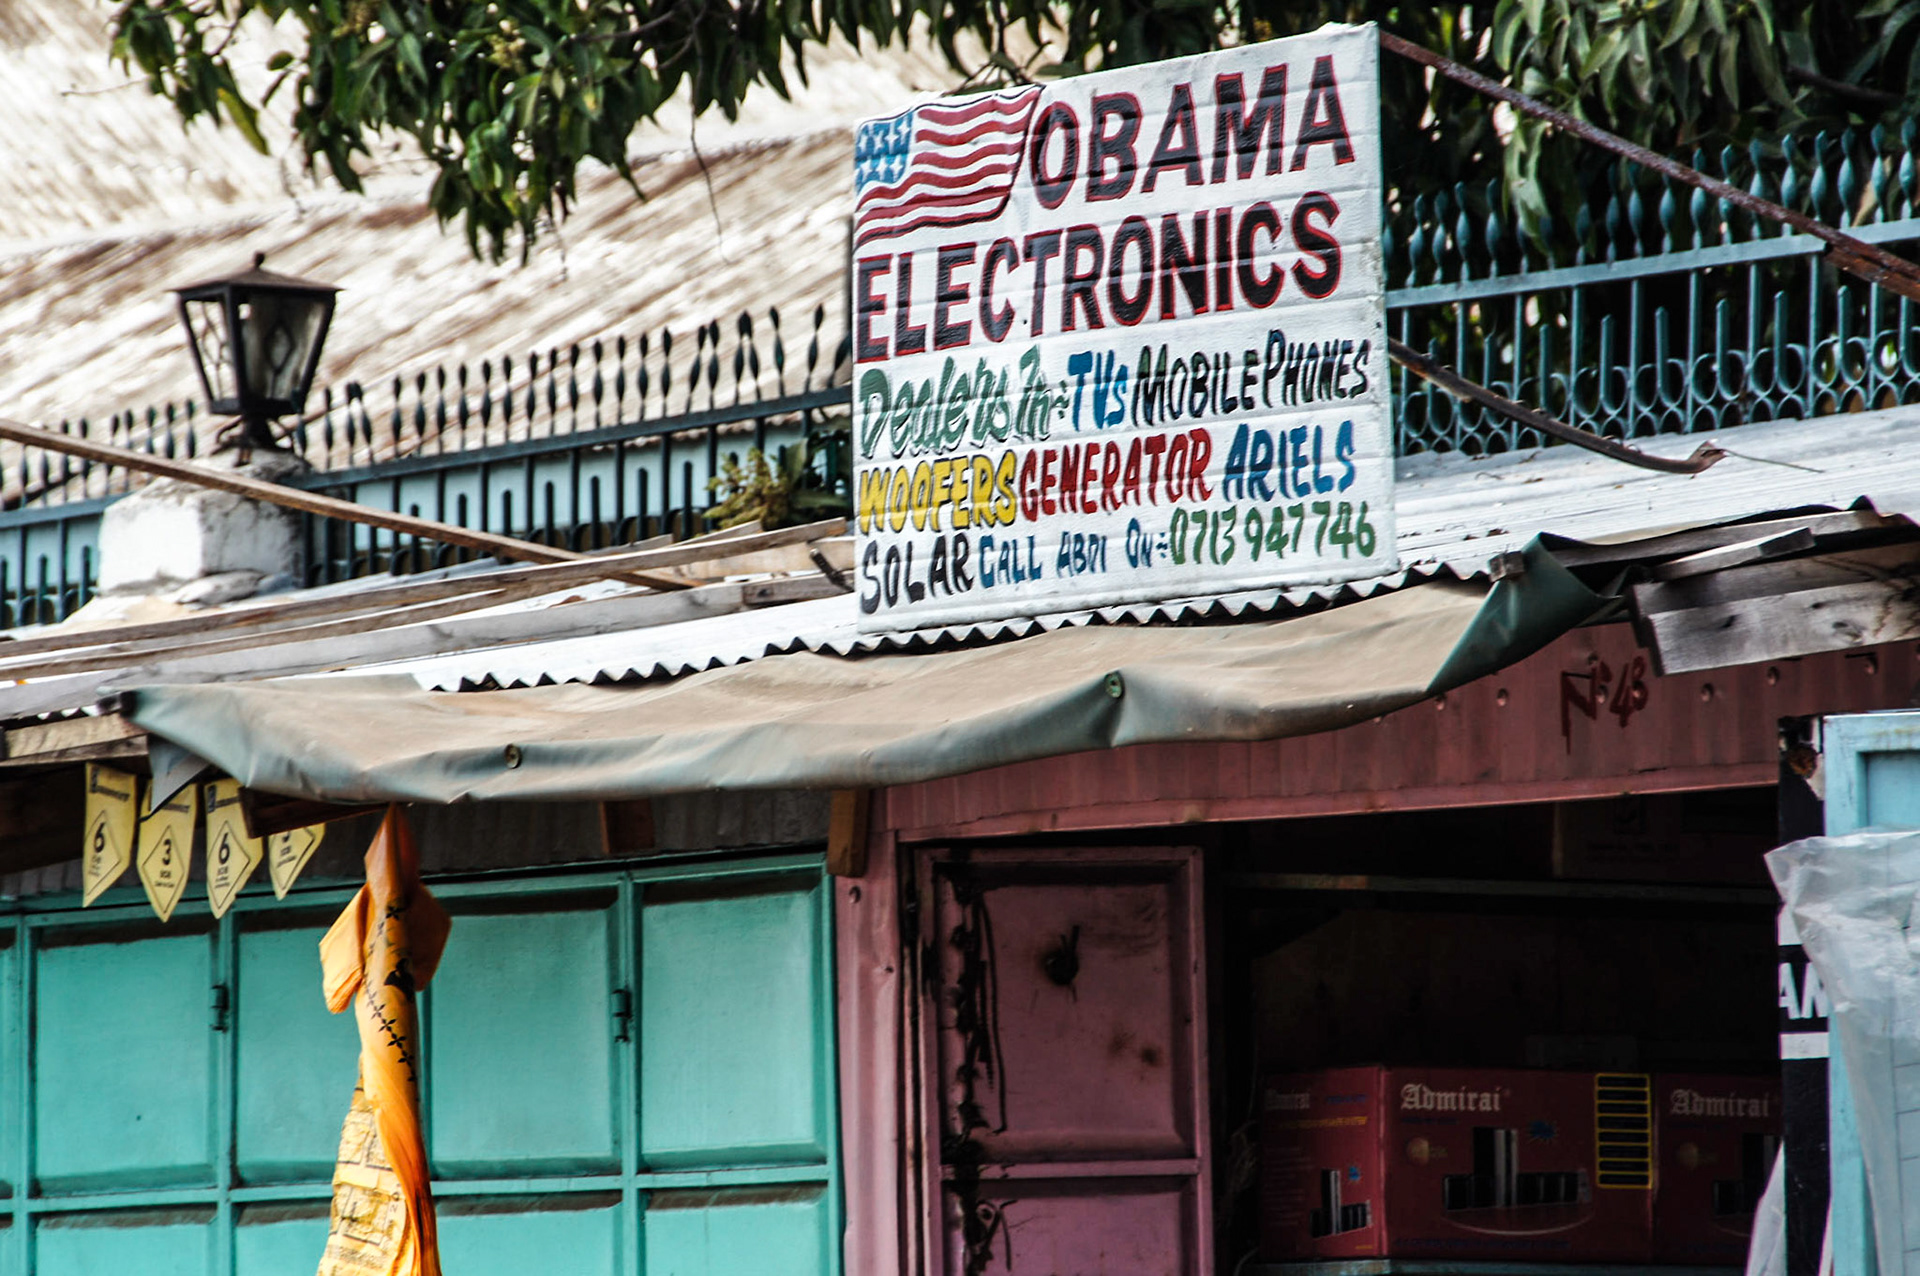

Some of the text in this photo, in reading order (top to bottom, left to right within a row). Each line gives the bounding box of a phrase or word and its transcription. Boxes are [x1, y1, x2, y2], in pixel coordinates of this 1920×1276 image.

[1029, 54, 1356, 210] OBAMA
[856, 190, 1343, 364] ELECTRONICS
[860, 355, 1011, 460] Dealers
[1068, 349, 1129, 432] TVs
[859, 420, 1357, 536] WOOFERS GENERATOR ARIELS
[860, 532, 975, 615] SOLAR
[979, 534, 1043, 589] CALL
[93, 821, 106, 854] 6
[161, 837, 173, 867] 3
[217, 832, 231, 865] 6
